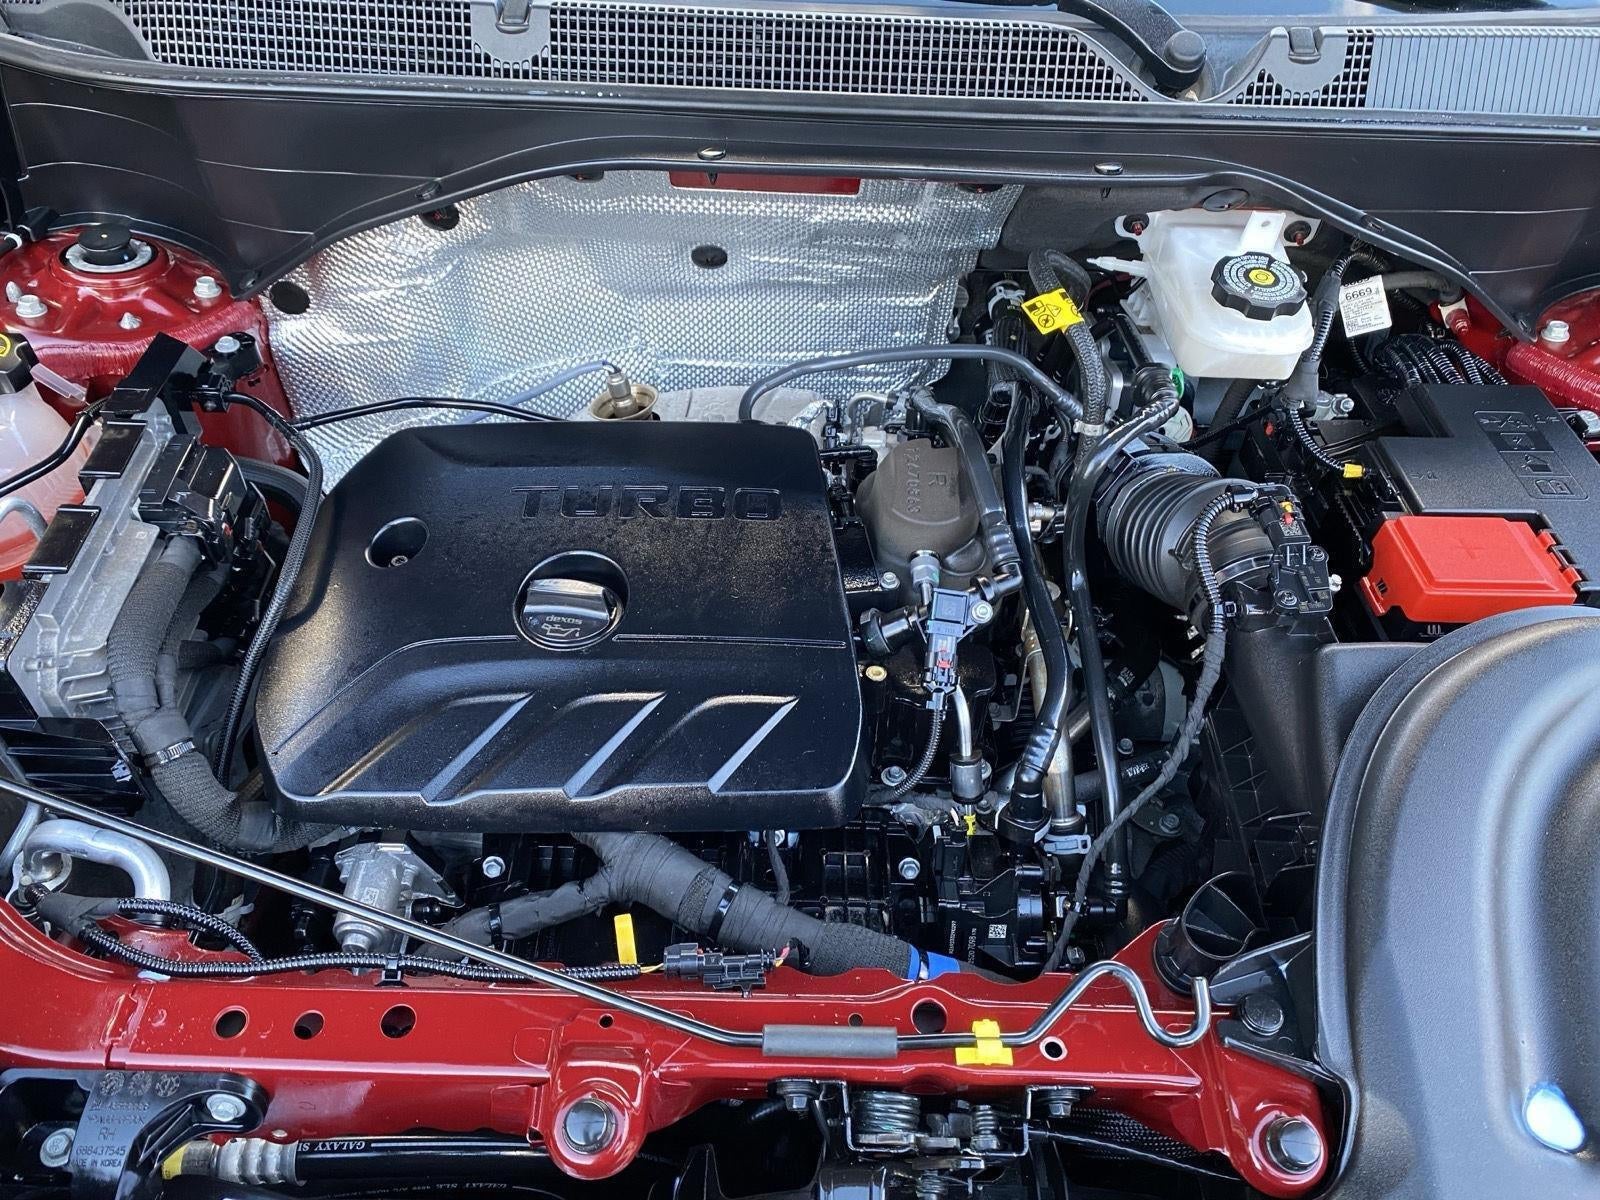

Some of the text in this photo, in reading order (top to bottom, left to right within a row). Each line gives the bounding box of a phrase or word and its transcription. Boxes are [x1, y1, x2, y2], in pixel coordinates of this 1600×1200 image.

[1345, 287, 1373, 301] 6669
[927, 472, 947, 487] R
[510, 485, 783, 521] TURBO
[545, 614, 583, 625] dexos
[314, 1140, 366, 1151] GALAXY
[91, 1159, 98, 1168] IN
[100, 1159, 122, 1168] KOREA
